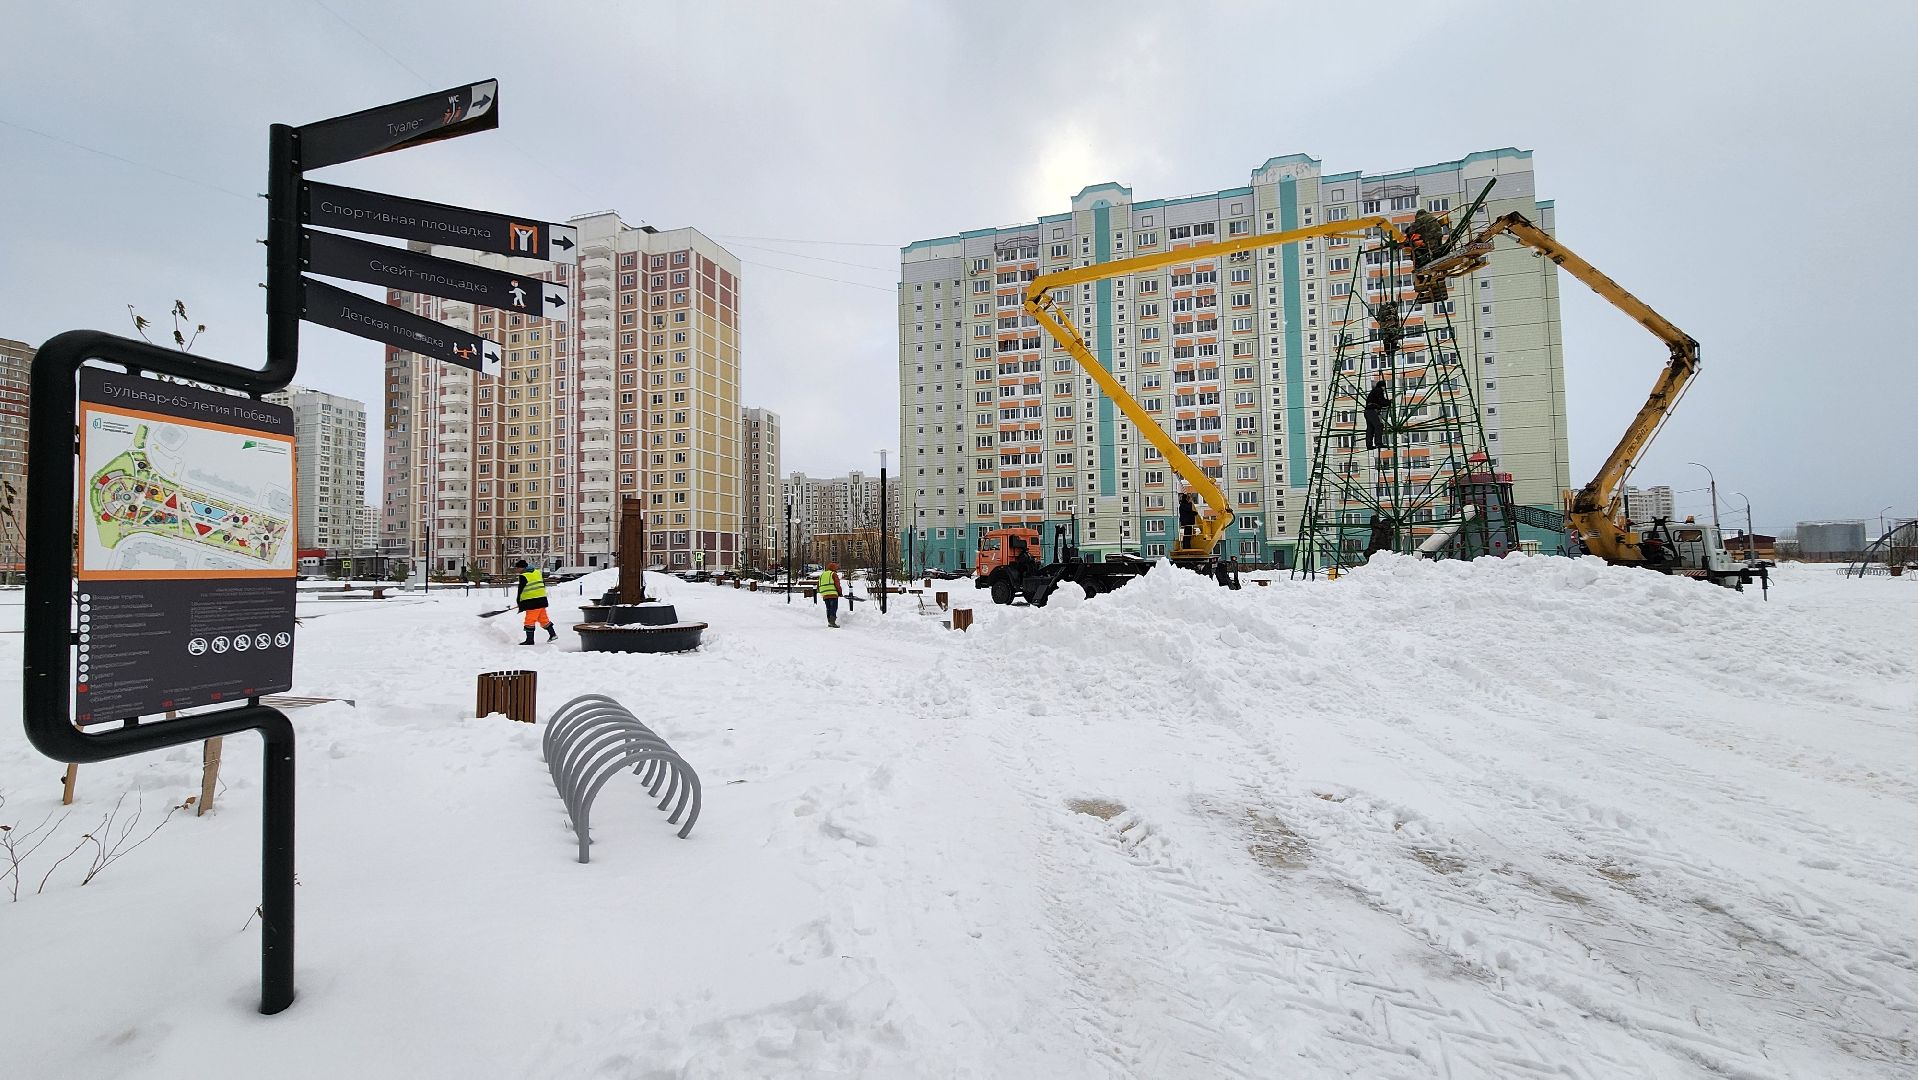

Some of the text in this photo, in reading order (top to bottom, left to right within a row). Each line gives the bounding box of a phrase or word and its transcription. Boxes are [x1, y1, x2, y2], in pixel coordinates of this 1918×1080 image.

[448, 95, 460, 104] WC
[320, 201, 492, 239] Спортивная площадка
[369, 260, 488, 294] Скейт-площадка
[340, 306, 390, 330] Детская
[103, 382, 282, 425] Бульвар-65-летия Победы
